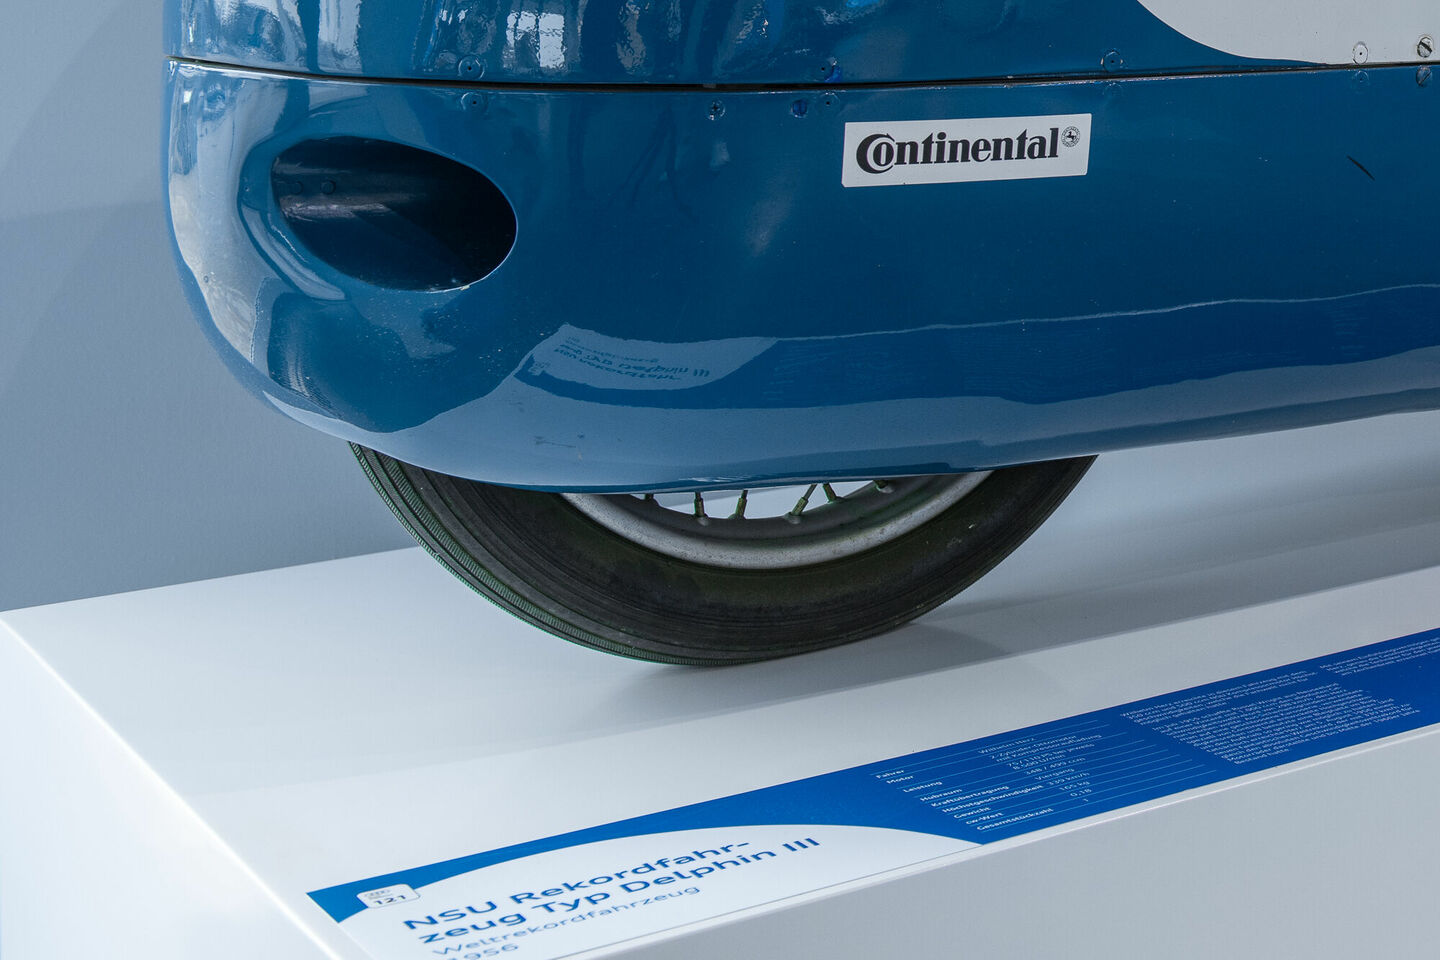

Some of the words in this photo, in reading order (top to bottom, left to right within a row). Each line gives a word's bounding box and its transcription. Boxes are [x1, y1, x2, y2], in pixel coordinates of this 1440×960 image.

[856, 127, 1059, 174] Continental
[876, 770, 904, 779] Fahrer
[886, 775, 914, 784] Motor
[903, 781, 943, 793] Leistung
[920, 789, 962, 801] Hubraum
[931, 786, 1009, 807] Kraftübertragung
[942, 785, 1043, 813] Höchstgeschwindigkeit
[953, 807, 991, 819] Gewicht
[977, 808, 1053, 830] Gesamtstückzahl
[403, 901, 498, 930] NSU
[510, 842, 749, 904] Rekordfahr-
[419, 913, 527, 944] zeug
[531, 892, 611, 912] Typ
[619, 849, 777, 893] Delphin
[782, 837, 821, 852] III
[373, 895, 406, 904] 121
[432, 886, 700, 955] Weltrekordfahrzeug
[448, 943, 519, 960] 956
